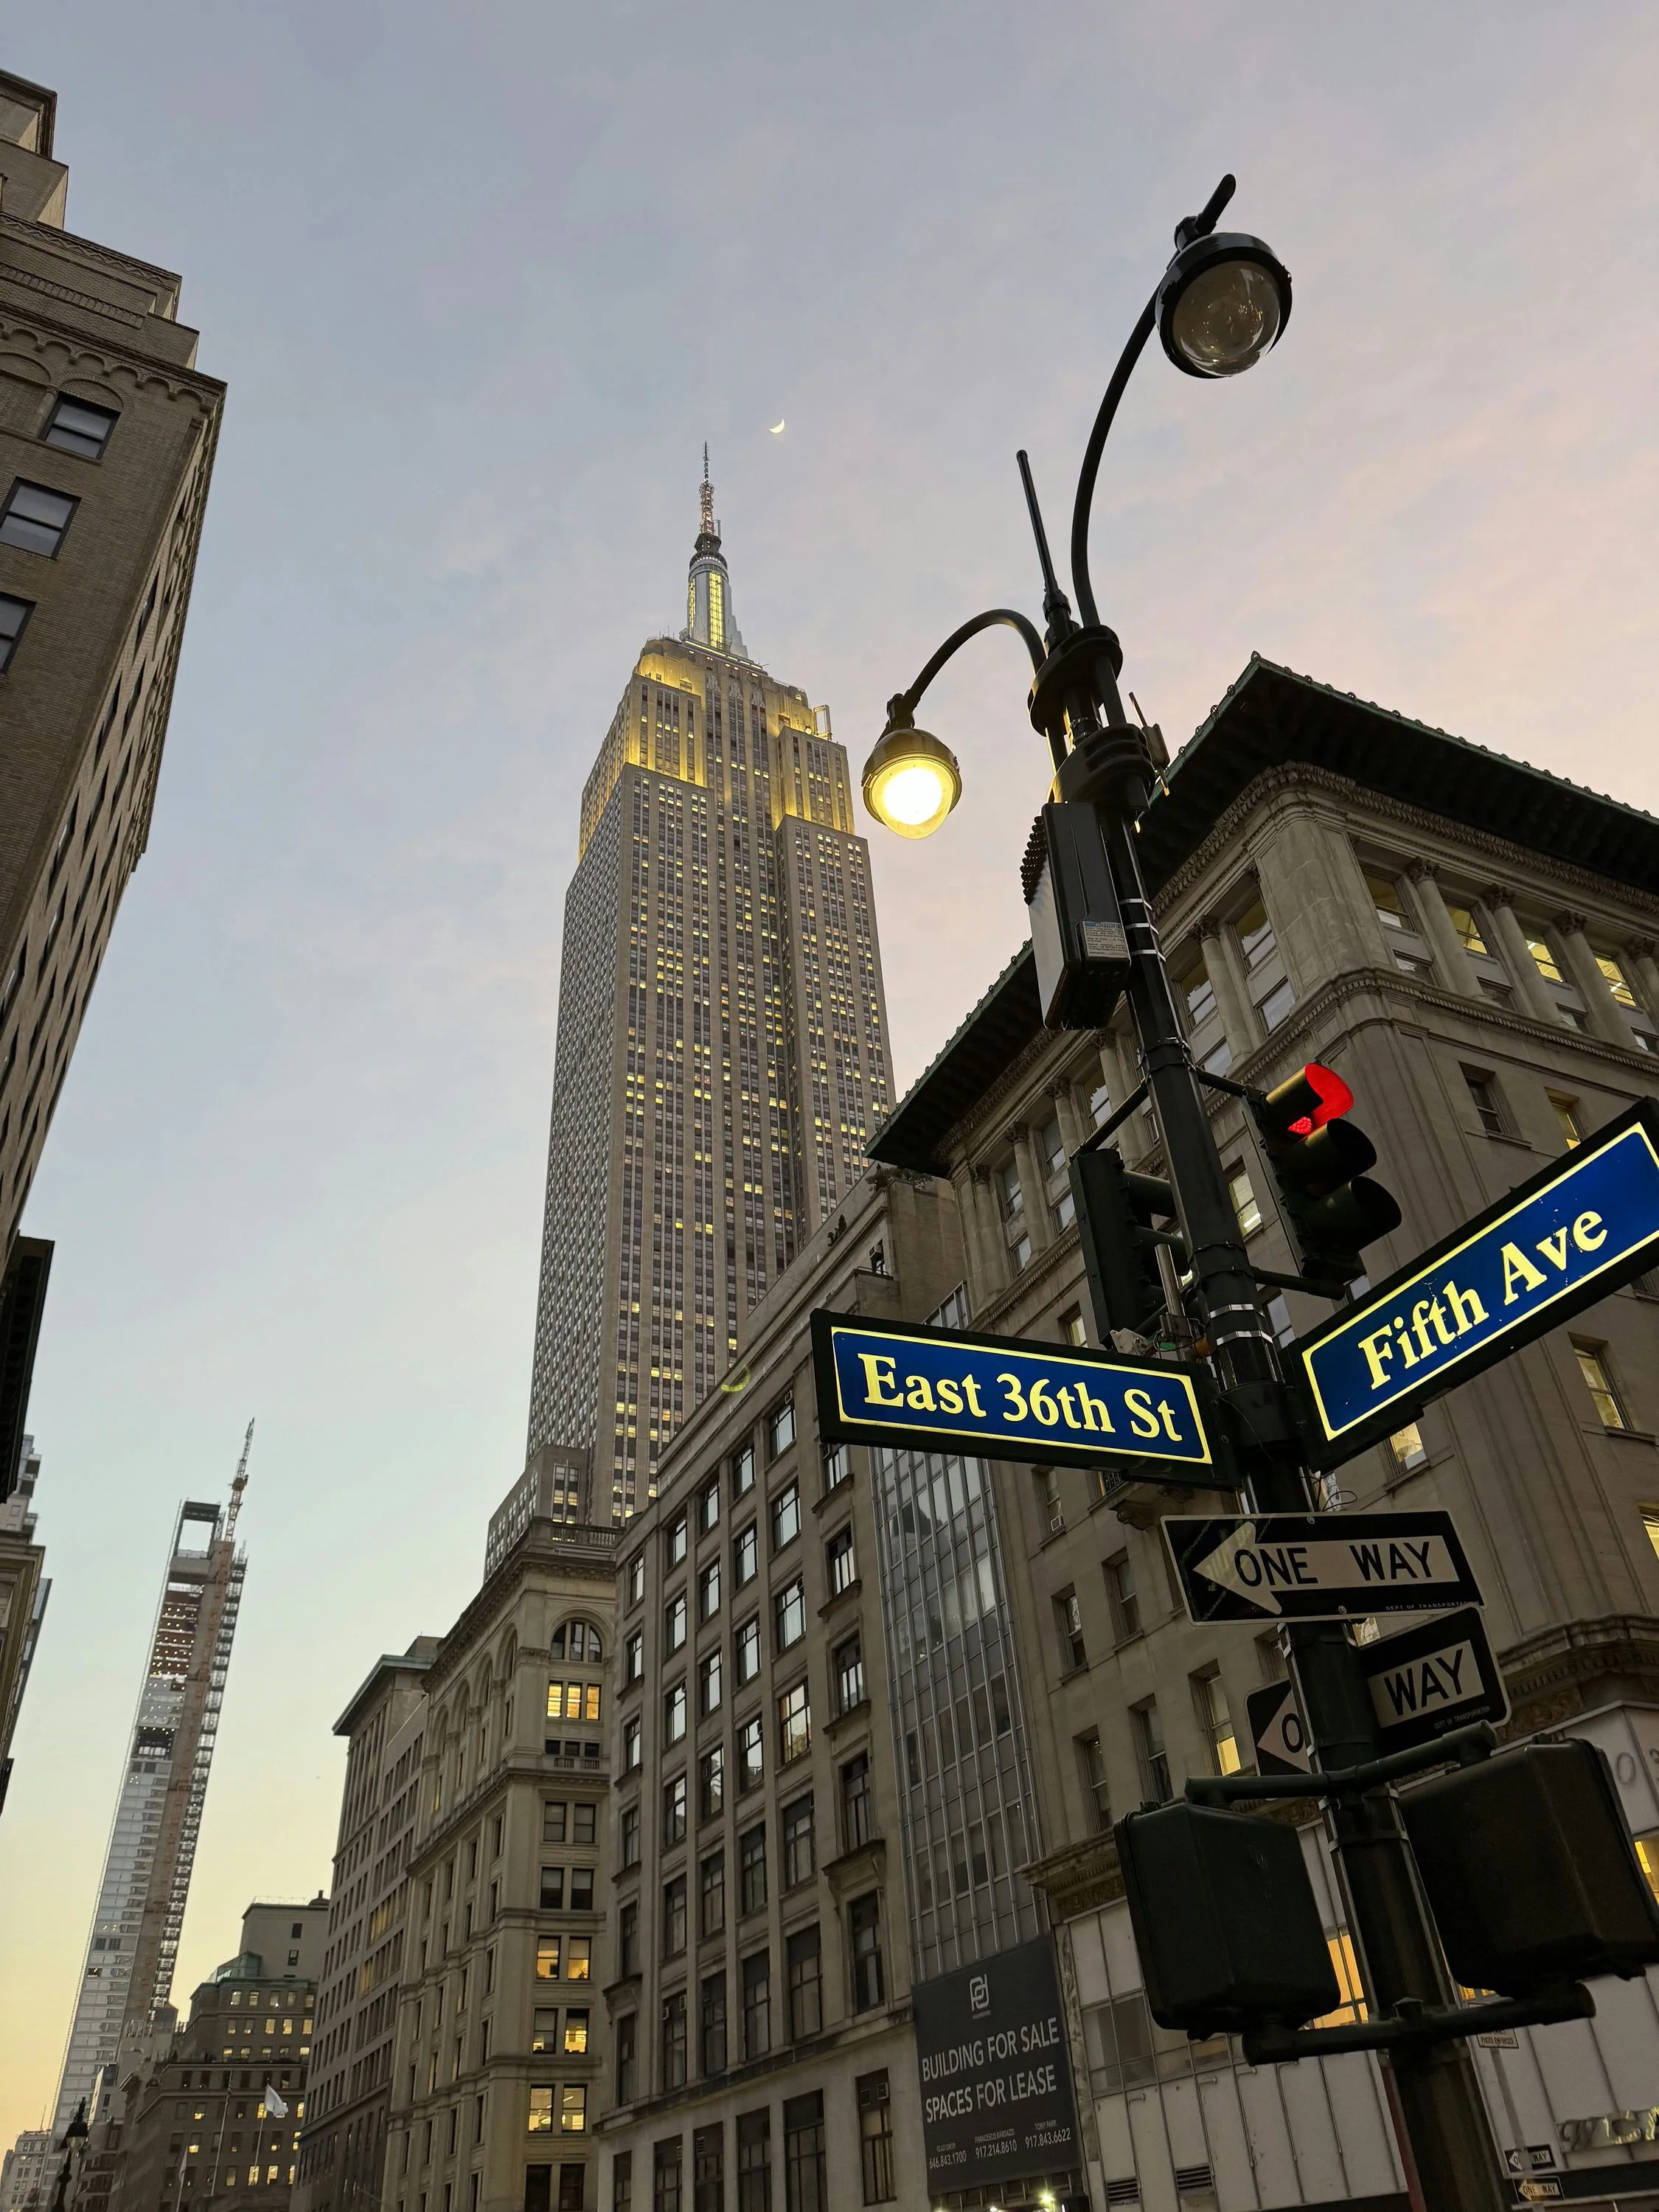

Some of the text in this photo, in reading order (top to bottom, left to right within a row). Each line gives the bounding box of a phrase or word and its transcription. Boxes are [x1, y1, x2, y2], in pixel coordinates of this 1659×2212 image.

[1357, 1210, 1608, 1391] Fifth Ave
[858, 1353, 1183, 1441] East 36th St
[1234, 1541, 1431, 1587] ONE WAY
[1384, 1649, 1463, 1716] WAY
[1434, 1720, 1445, 1730] DEPT
[922, 2017, 1059, 2081] BUILDING FOR SALE
[925, 2065, 1057, 2124] SPACES FOR LEASE
[1034, 2119, 1057, 2131] TONY PARK
[975, 2132, 996, 2143] FRANCESCO
[1025, 2127, 1071, 2149] 917.843.6622
[929, 2149, 967, 2169] 646.843.1700
[975, 2139, 1018, 2159] 917.214.8610
[1532, 2152, 1546, 2162] WAY
[1523, 2185, 1556, 2194] ONE WAY
